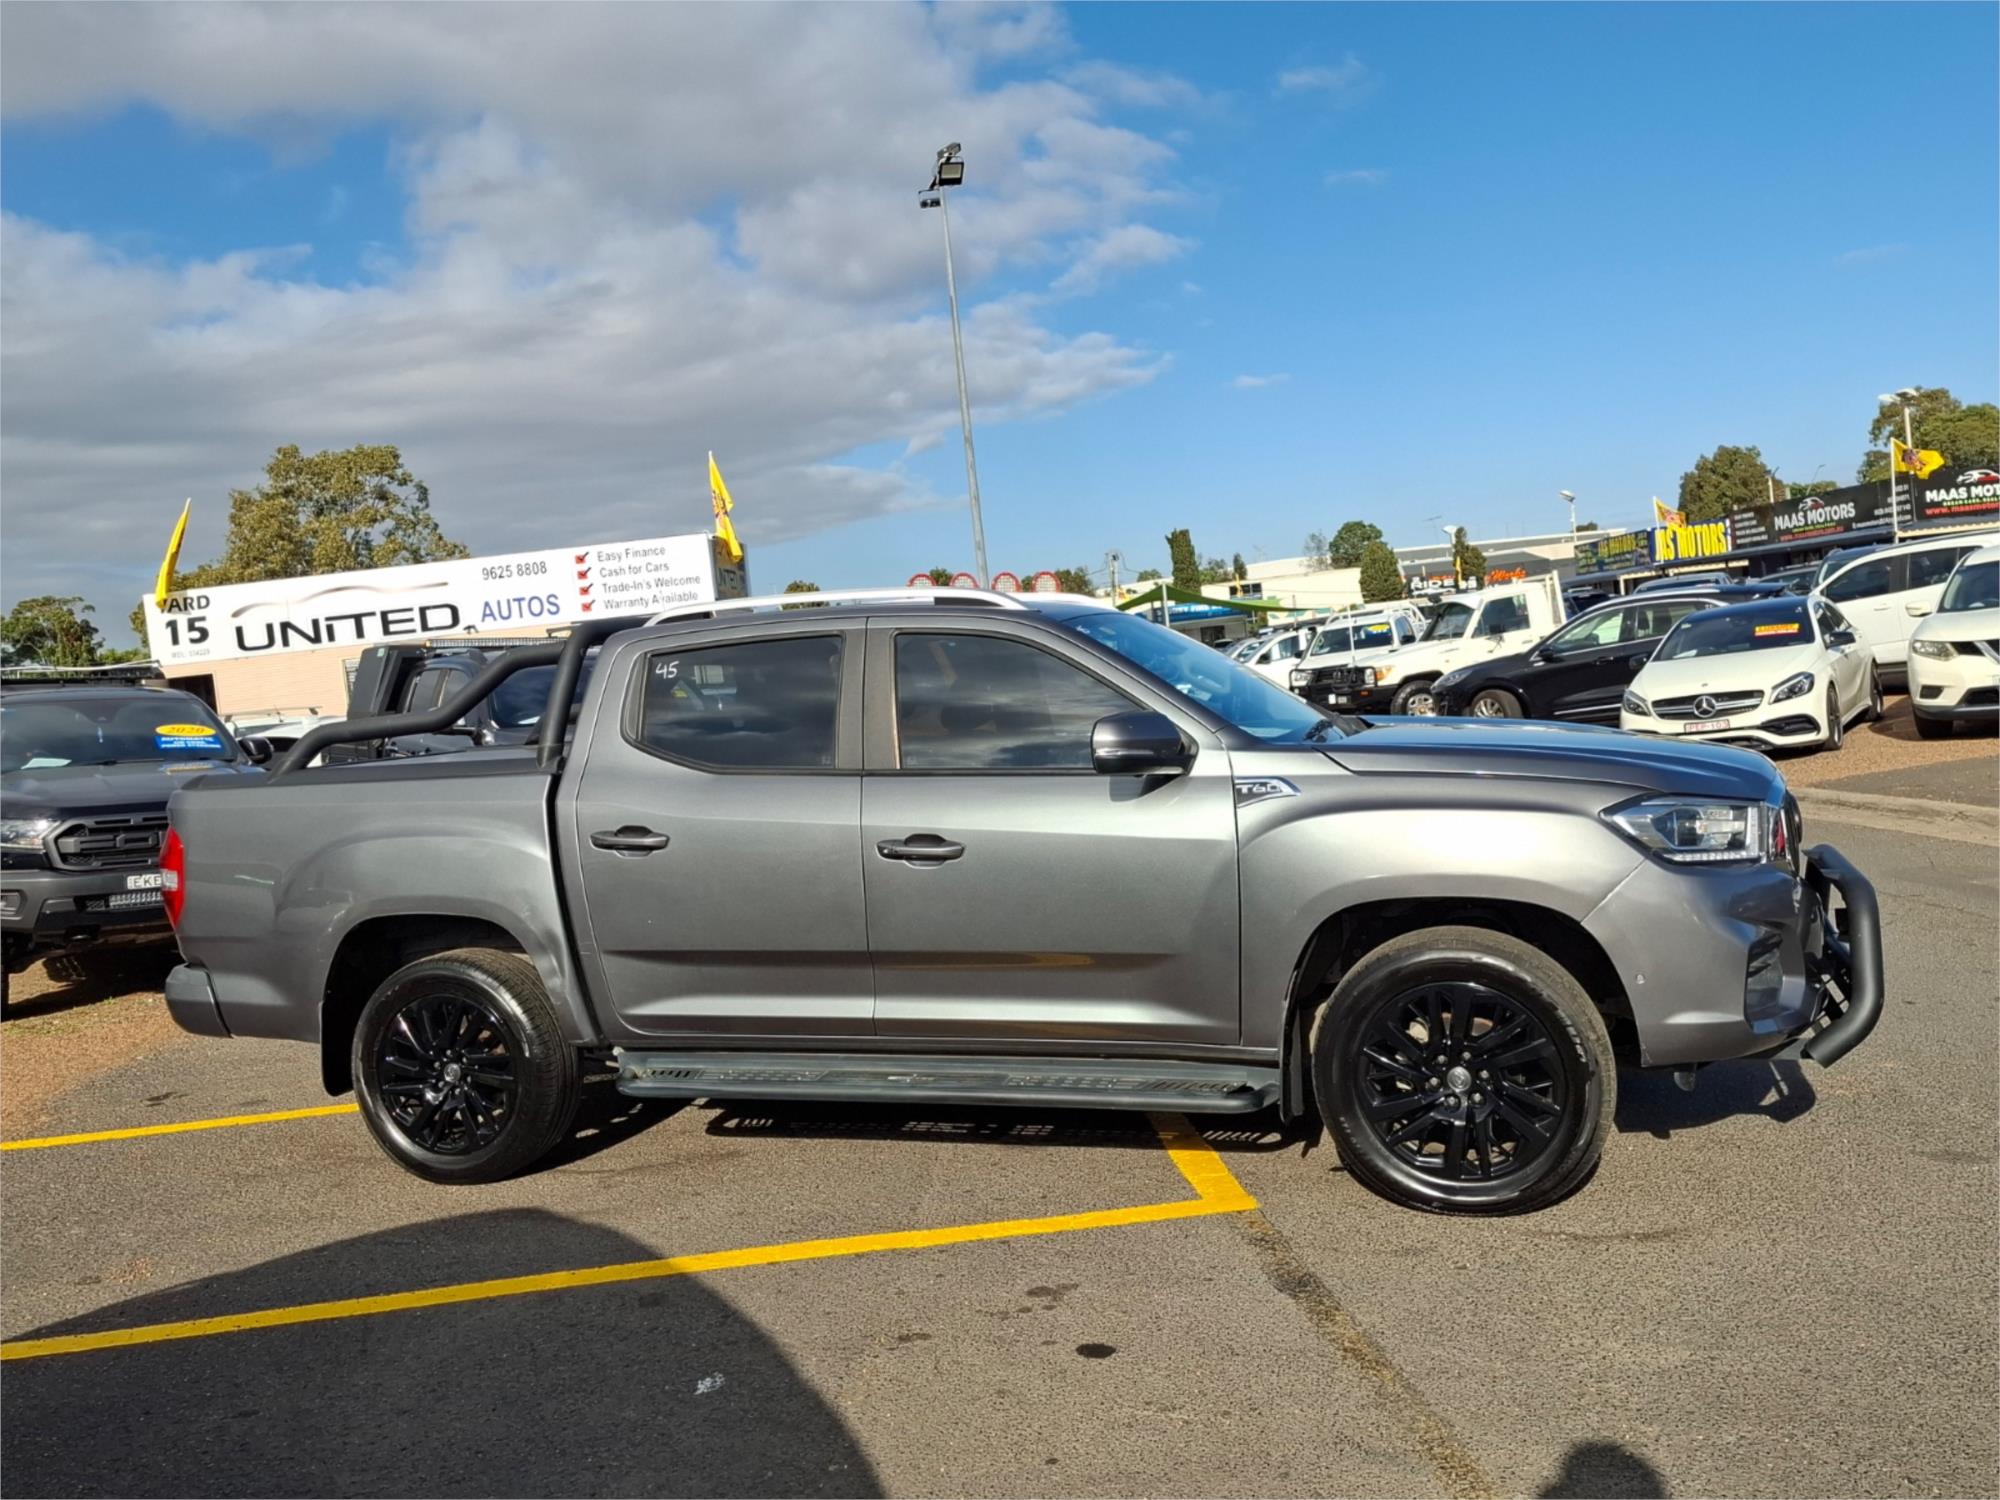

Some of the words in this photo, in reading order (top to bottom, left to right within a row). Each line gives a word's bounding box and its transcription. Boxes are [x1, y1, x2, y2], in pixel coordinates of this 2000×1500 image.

[1925, 487, 1968, 503] MAAS
[1774, 511, 1805, 531] MAAS
[1807, 502, 1856, 525] MOTORS
[1676, 521, 1727, 559] MOTORS
[597, 551, 622, 562] Easy
[624, 547, 666, 558] Finance
[481, 565, 513, 580] 9625
[516, 560, 547, 577] 8808
[599, 566, 626, 578] Cash
[628, 564, 642, 575] for
[645, 562, 670, 573] Cars
[654, 576, 701, 588] Welcome
[481, 593, 560, 622] AUTOS
[604, 597, 649, 609] Warranty
[165, 615, 210, 647] 15
[655, 660, 680, 679] 45
